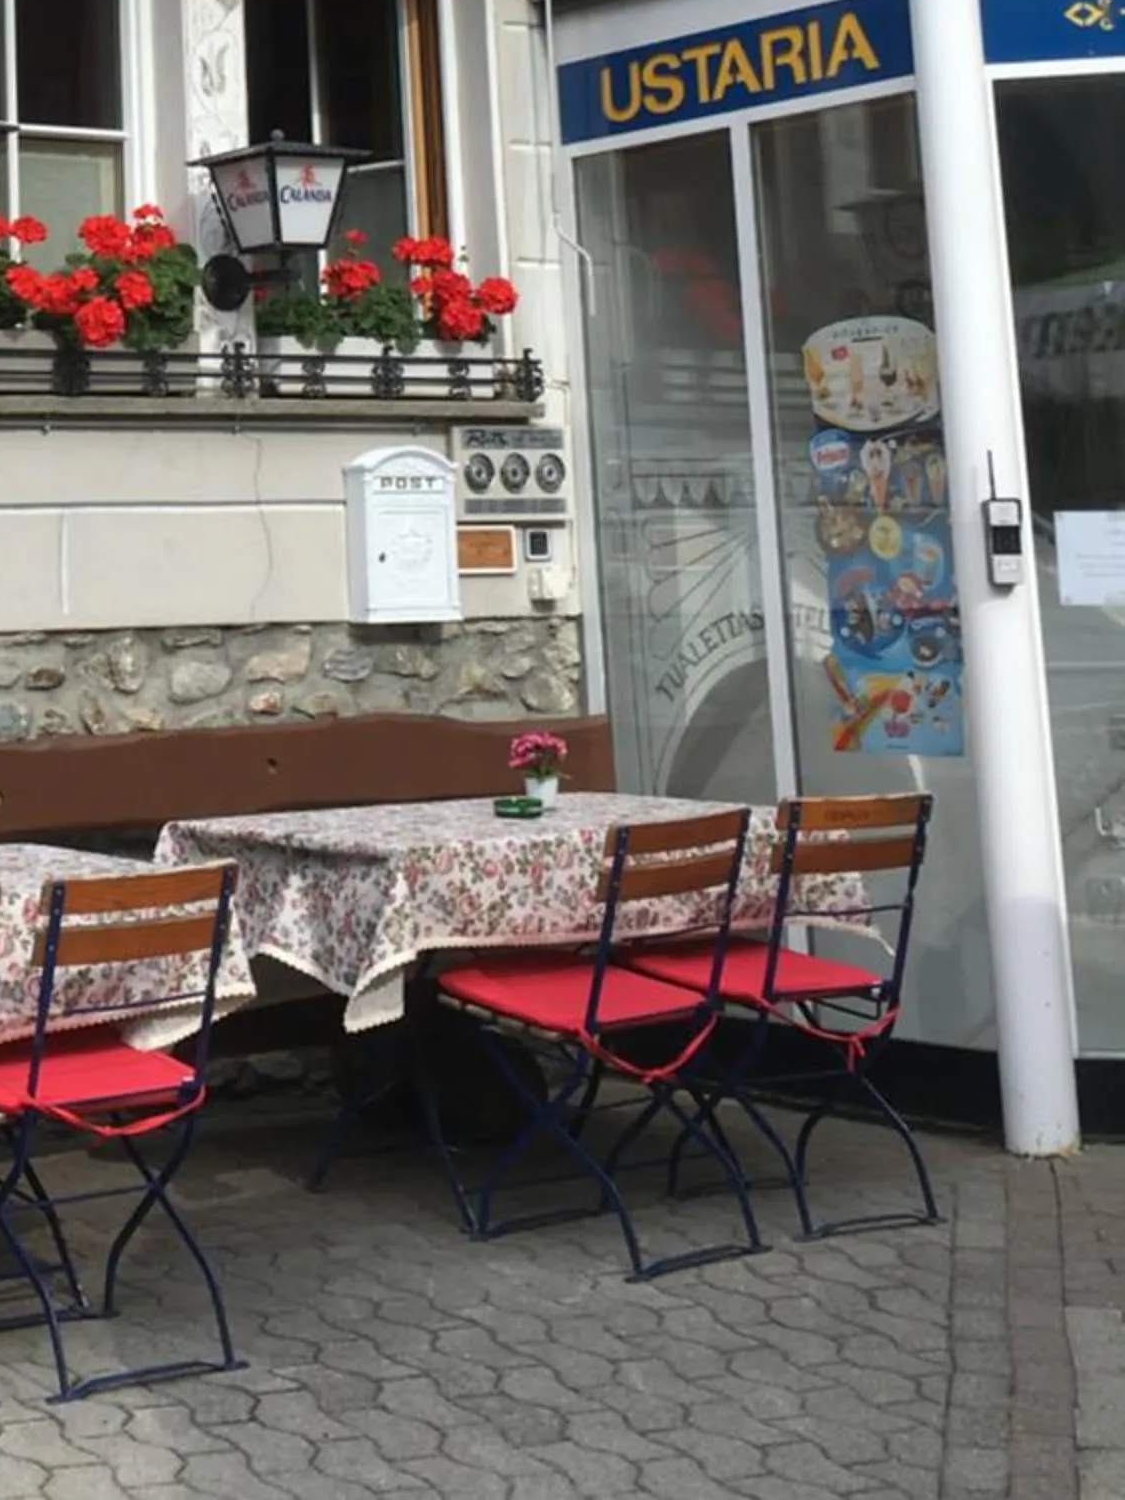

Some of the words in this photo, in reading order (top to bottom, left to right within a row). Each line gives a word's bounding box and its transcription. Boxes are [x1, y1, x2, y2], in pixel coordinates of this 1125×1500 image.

[601, 11, 880, 124] USTARIA
[279, 184, 332, 204] CALANDA
[379, 475, 438, 490] POST
